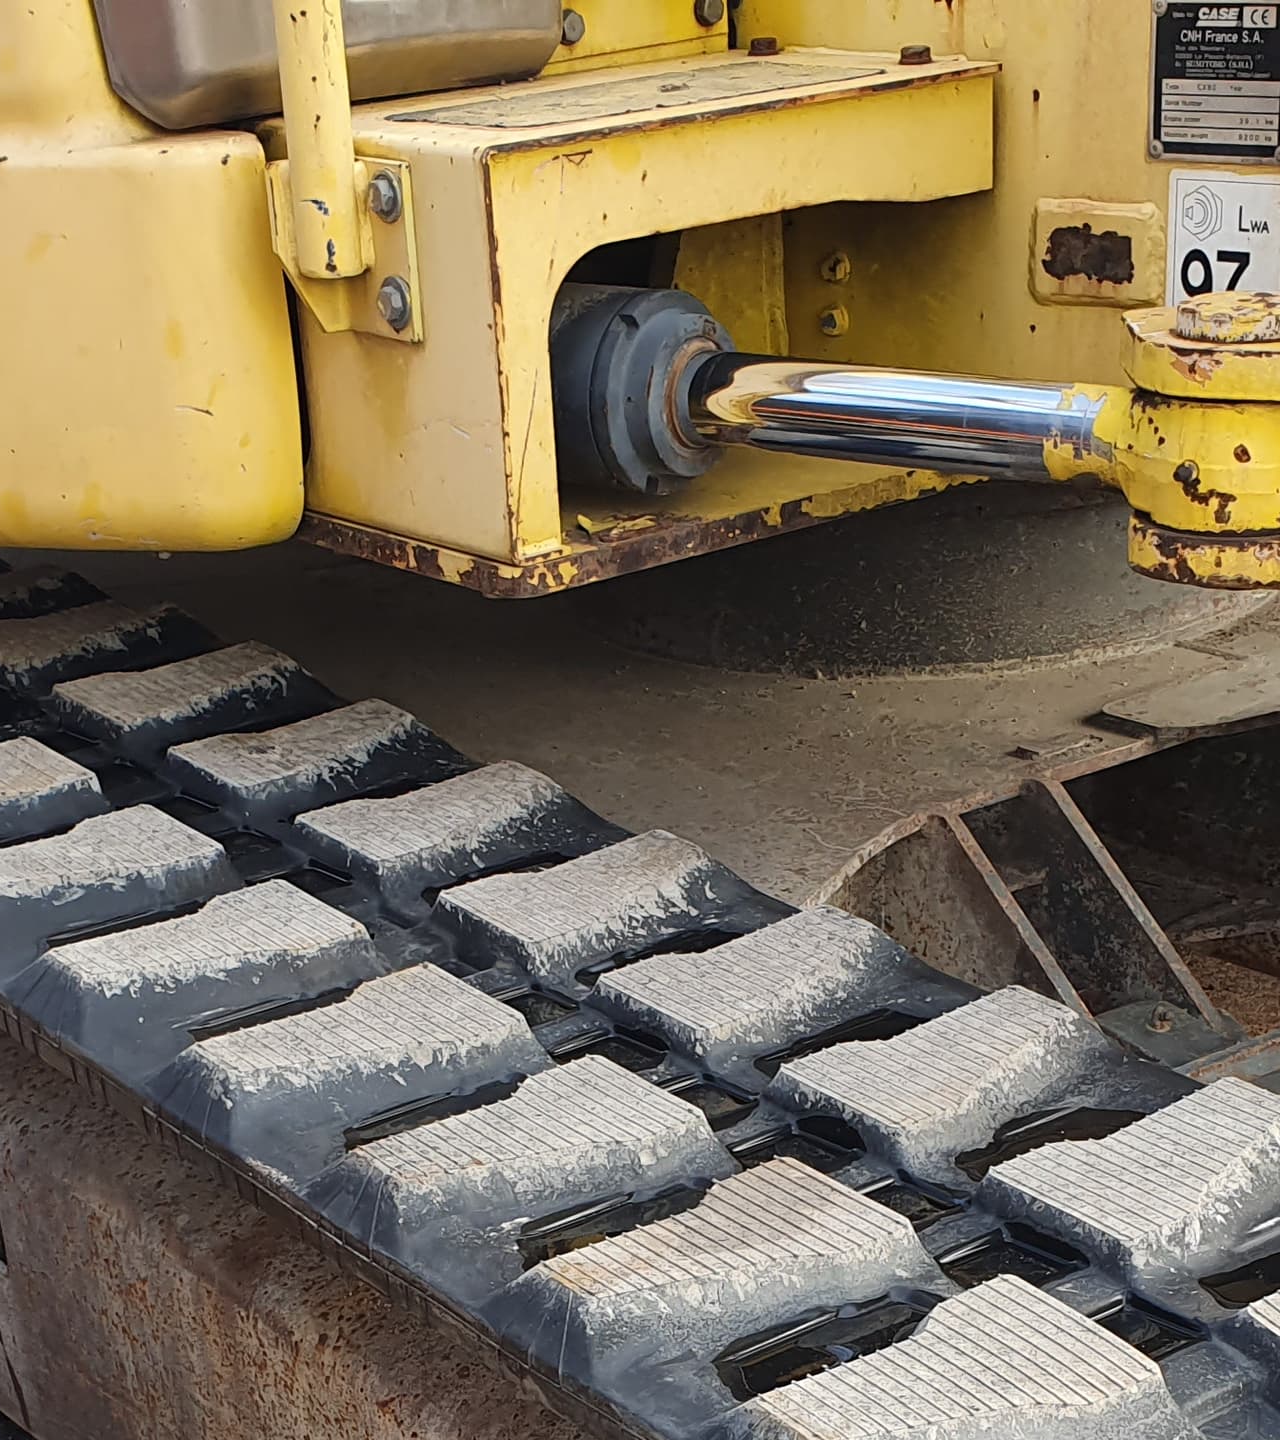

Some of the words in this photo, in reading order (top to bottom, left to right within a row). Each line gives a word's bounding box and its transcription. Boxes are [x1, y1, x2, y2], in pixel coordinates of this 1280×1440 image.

[1197, 6, 1241, 20] CASE
[1250, 9, 1270, 25] CE
[1180, 30, 1202, 43] CNH
[1205, 30, 1239, 43] France
[1242, 31, 1265, 44] S.A.
